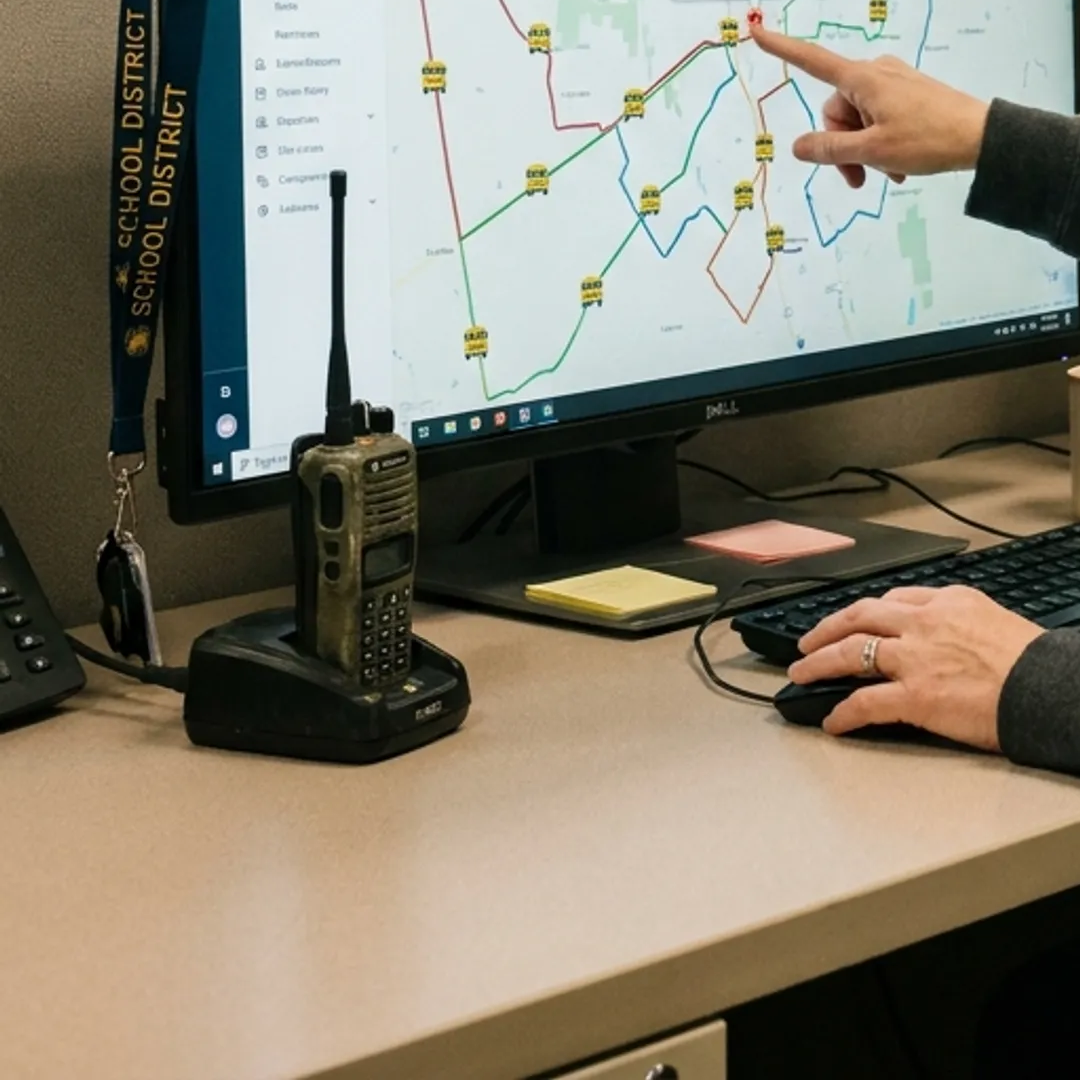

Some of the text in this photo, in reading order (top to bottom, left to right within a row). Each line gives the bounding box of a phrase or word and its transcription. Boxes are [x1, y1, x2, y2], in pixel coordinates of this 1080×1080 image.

[122, 8, 145, 129] DISTRICT
[131, 83, 187, 316] SCHOOL DISTRICT
